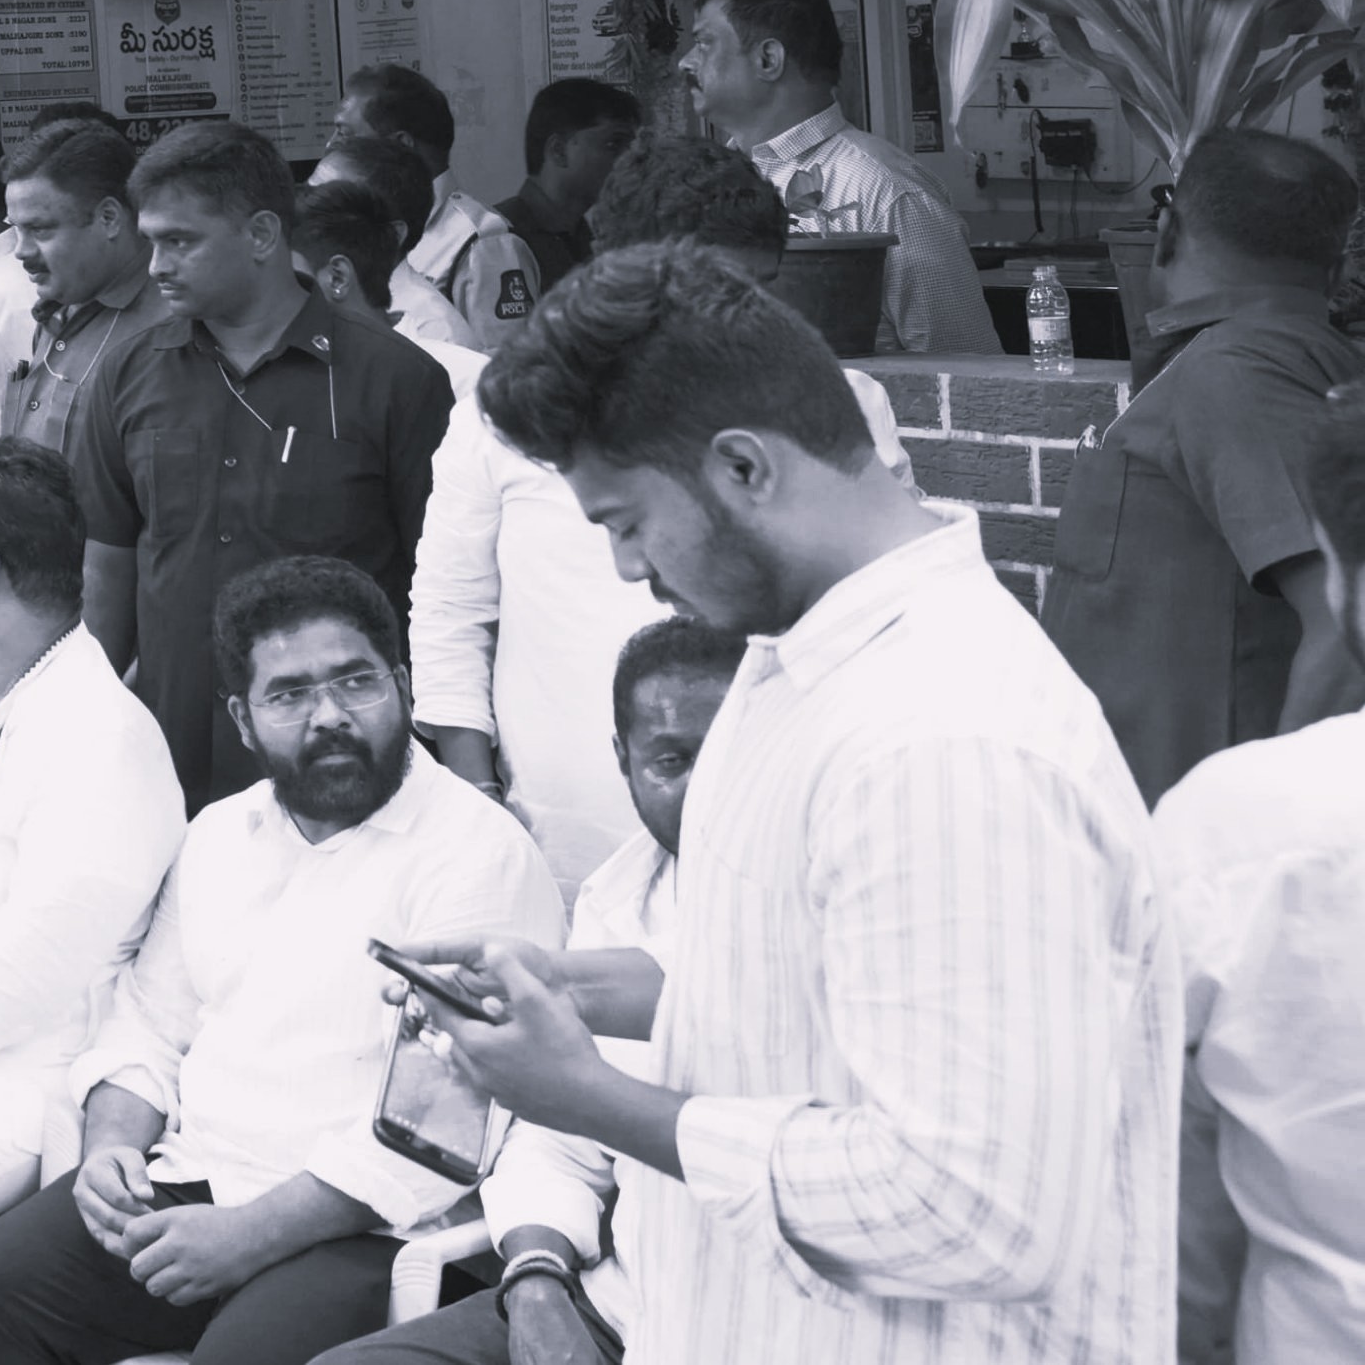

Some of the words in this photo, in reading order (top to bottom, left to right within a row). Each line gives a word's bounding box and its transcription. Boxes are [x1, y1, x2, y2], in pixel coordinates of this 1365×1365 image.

[120, 22, 146, 53] మీ
[152, 25, 216, 61] సురక్ష
[125, 84, 148, 93] POLICE
